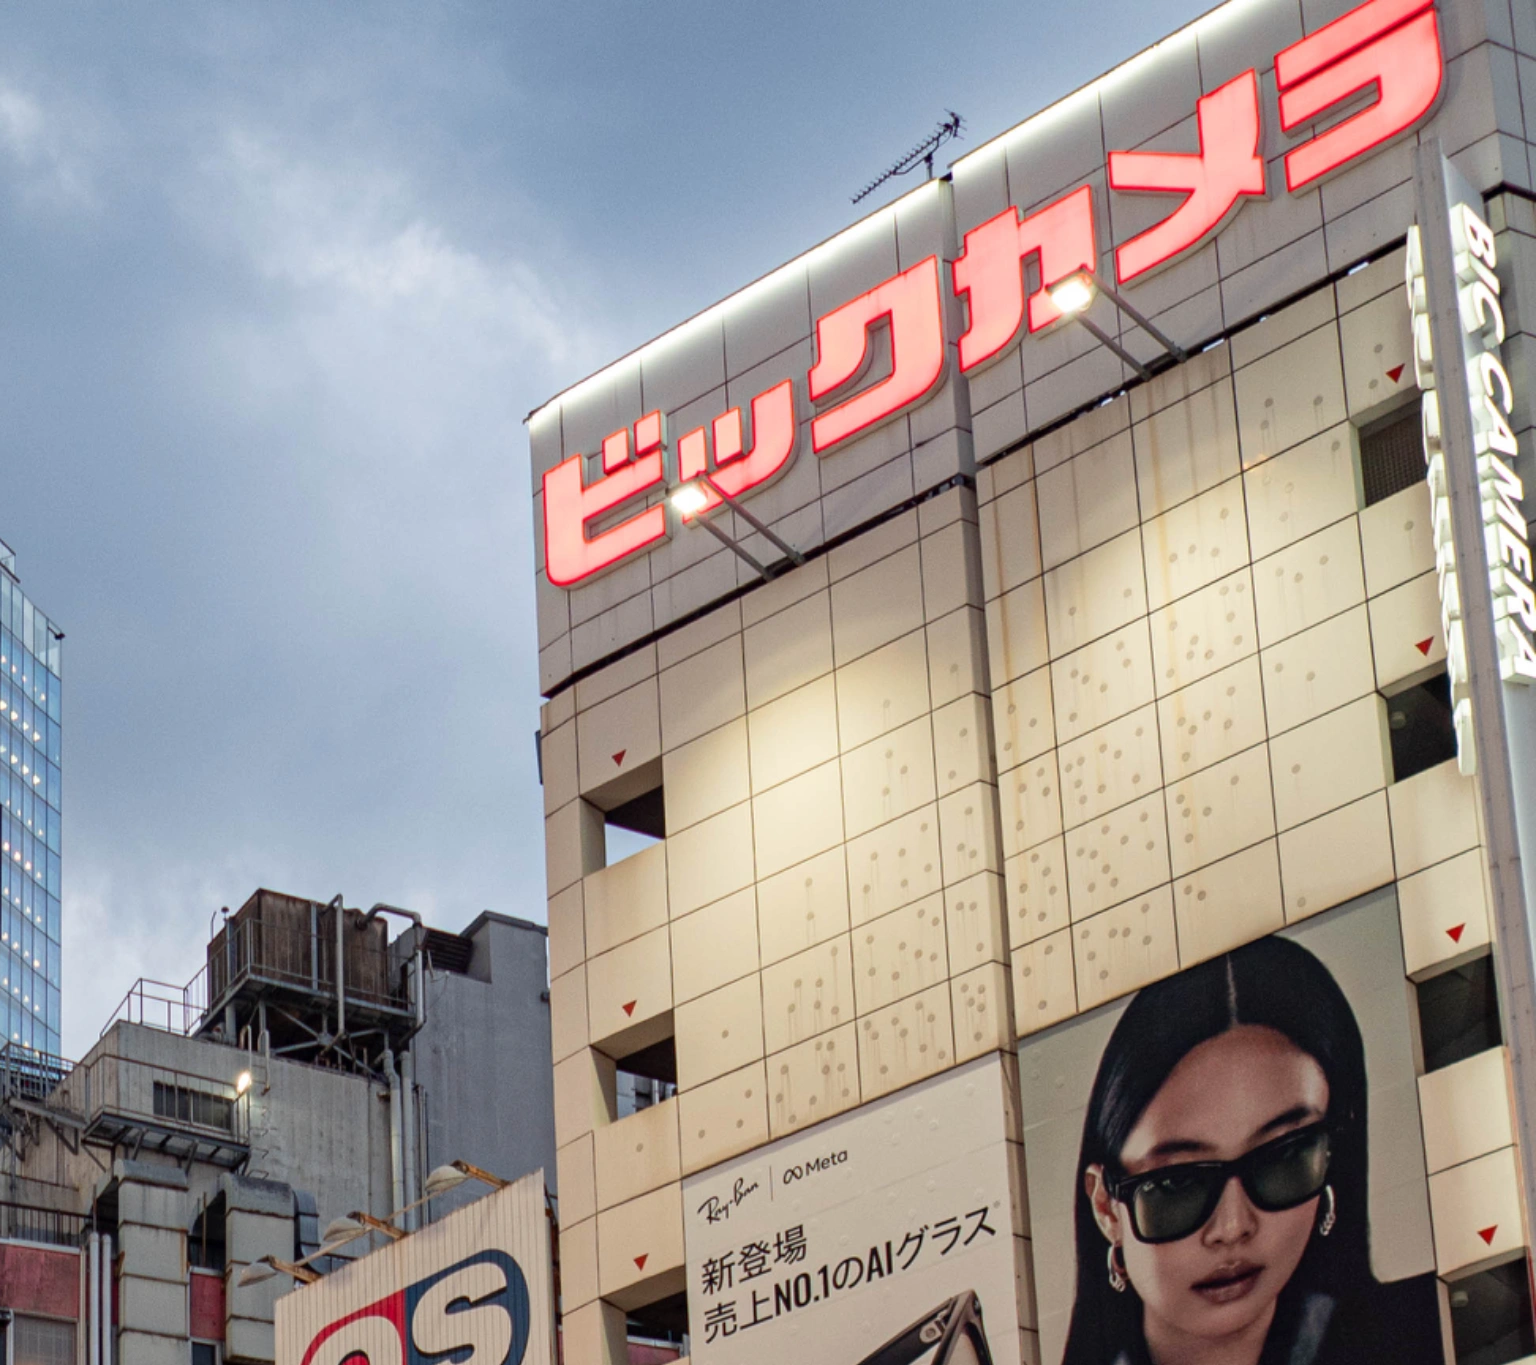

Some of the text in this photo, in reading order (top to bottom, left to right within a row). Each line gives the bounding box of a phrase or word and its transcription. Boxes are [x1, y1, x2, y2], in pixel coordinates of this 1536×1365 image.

[544, 0, 1444, 588] ビックカメラ
[1464, 203, 1506, 347] BIC
[804, 1148, 849, 1178] Meta
[701, 1224, 808, 1296] 新登場
[704, 1205, 997, 1345] 売上NO.1のAIグラス
